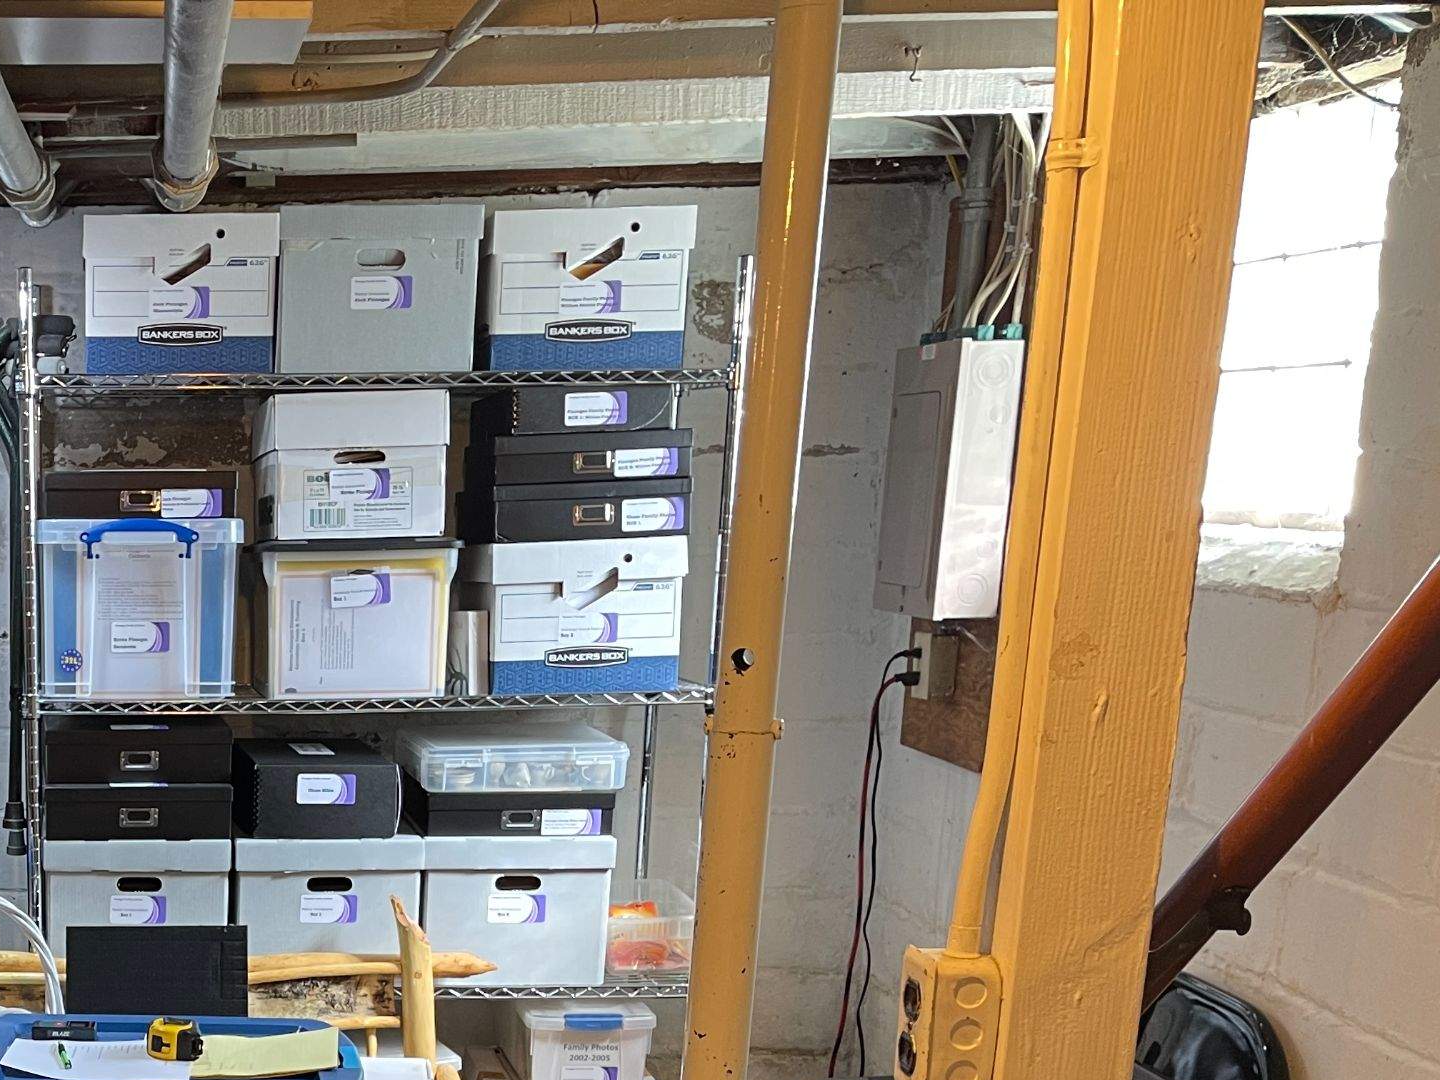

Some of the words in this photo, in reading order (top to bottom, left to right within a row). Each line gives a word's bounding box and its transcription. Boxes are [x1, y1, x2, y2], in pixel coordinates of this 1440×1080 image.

[141, 330, 195, 339] BANKERS
[196, 330, 220, 339] BOX
[548, 325, 603, 336] BANKERS
[603, 325, 629, 335] BOX
[548, 653, 601, 662] BANKERS
[602, 652, 625, 660] BOX
[563, 1043, 589, 1052] Family
[591, 1043, 618, 1051] Photos
